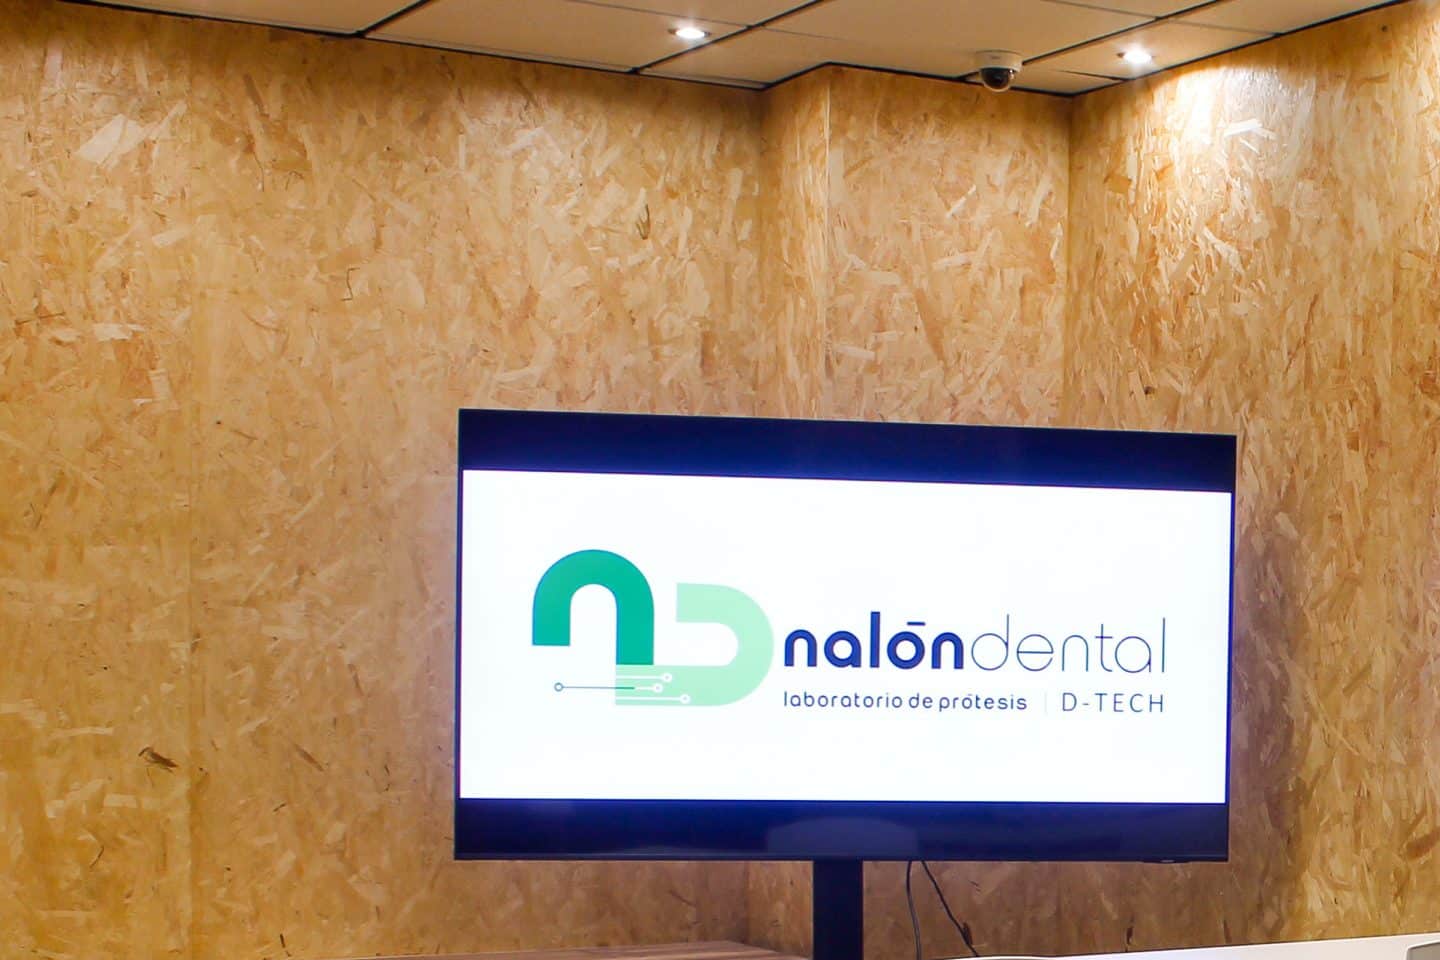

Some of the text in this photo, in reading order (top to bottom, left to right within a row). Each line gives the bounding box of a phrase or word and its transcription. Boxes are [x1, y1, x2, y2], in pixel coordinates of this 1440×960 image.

[784, 690, 904, 709] laboratorio
[908, 692, 934, 710] de
[1061, 691, 1164, 713] D-TECH
